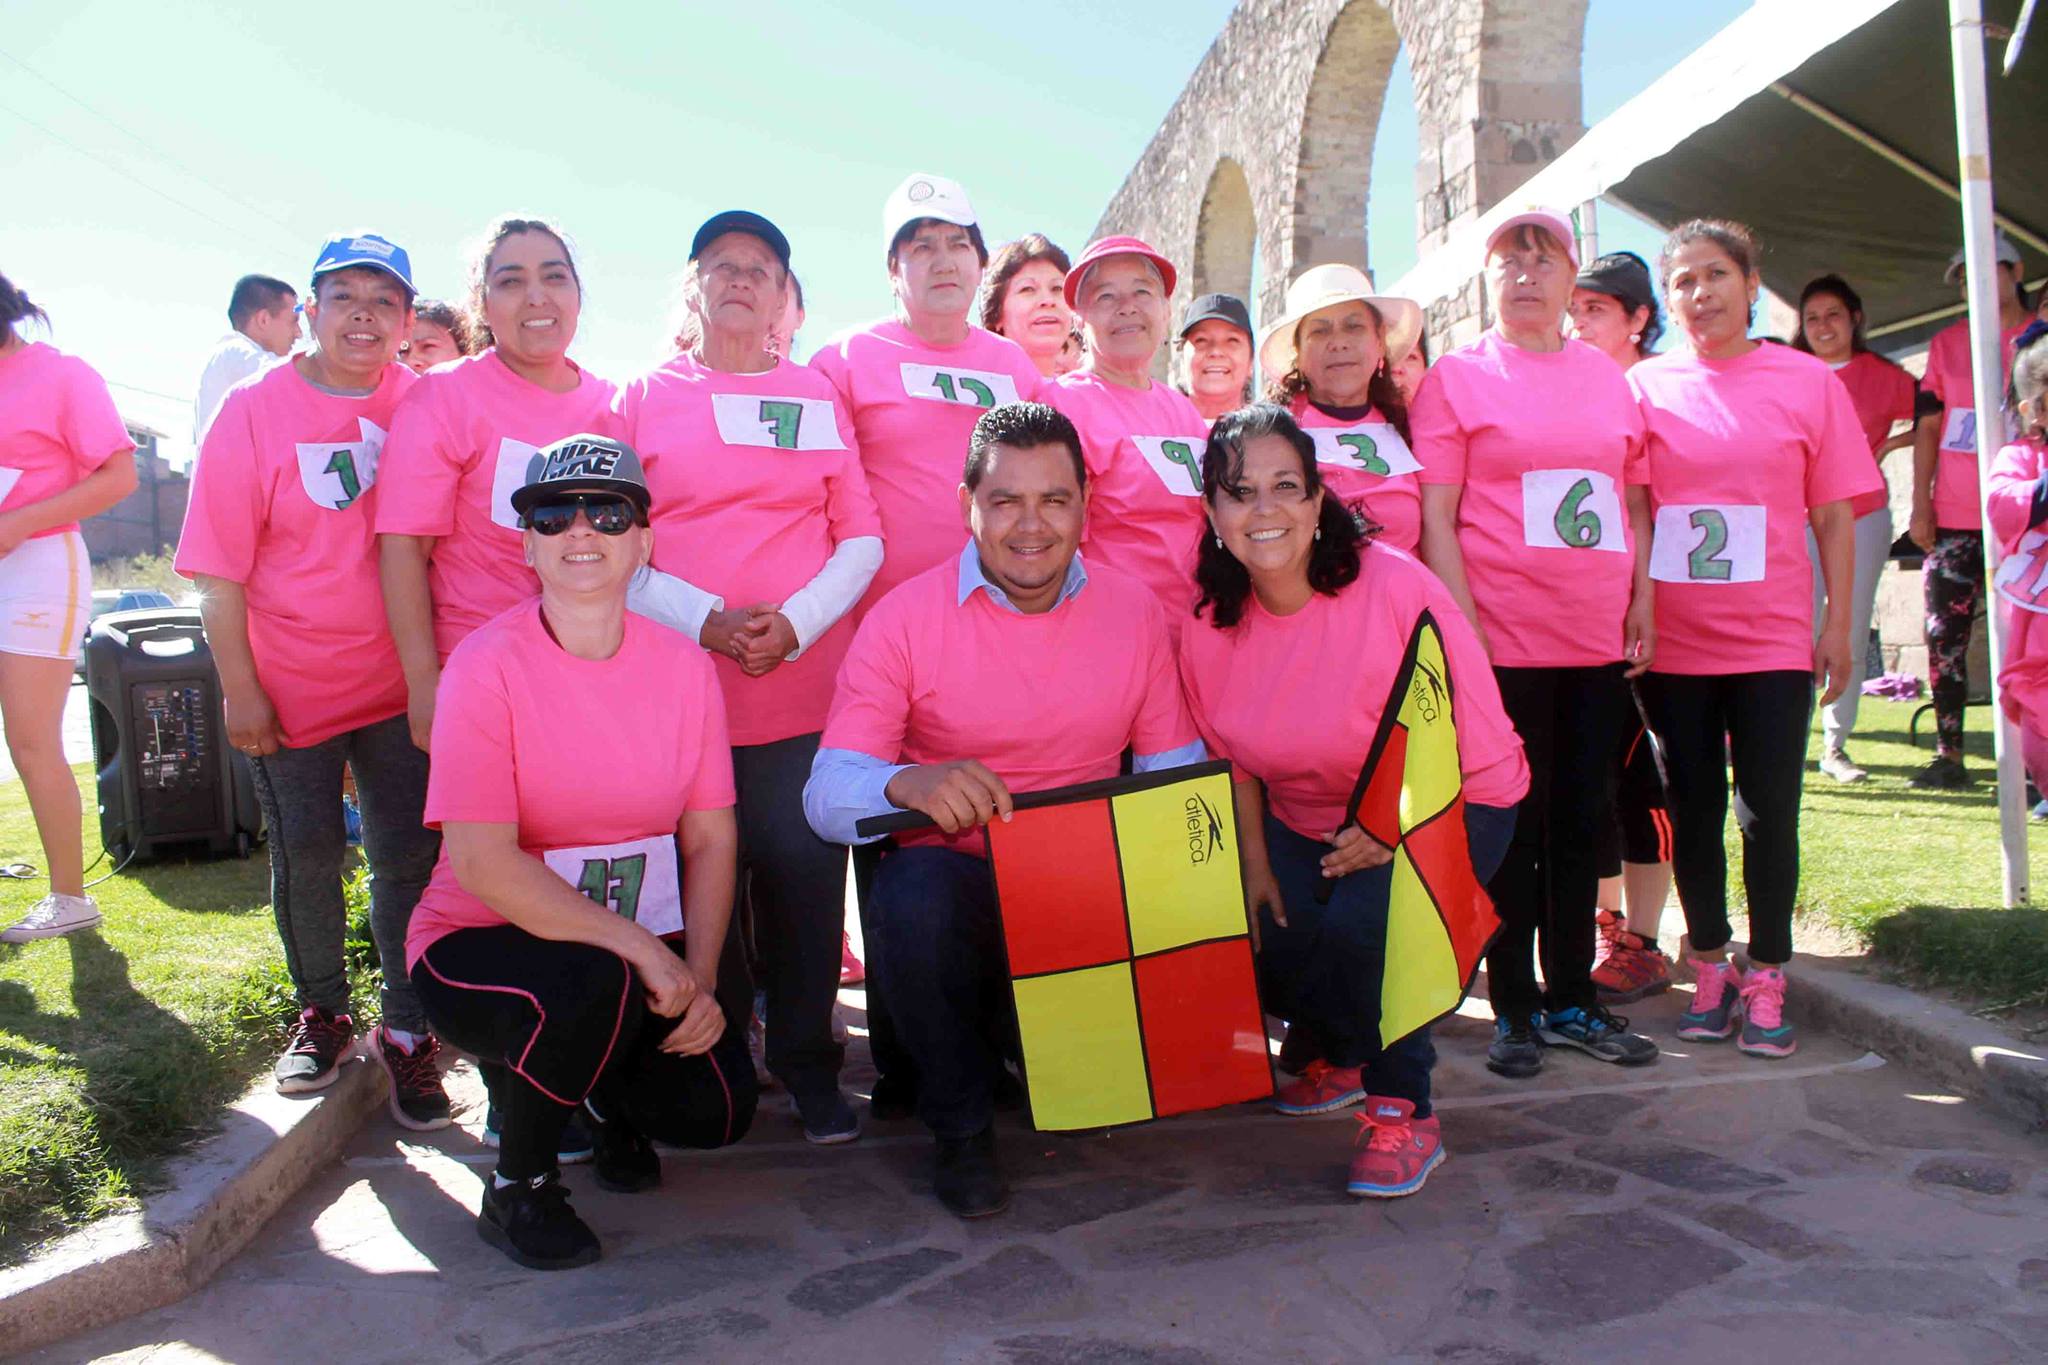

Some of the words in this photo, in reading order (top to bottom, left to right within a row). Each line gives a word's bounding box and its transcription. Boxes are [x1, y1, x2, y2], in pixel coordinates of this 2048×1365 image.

[759, 400, 803, 448] 7
[538, 443, 622, 483] NIKE
[1161, 440, 1204, 492] 9
[1336, 433, 1390, 475] 3
[1554, 477, 1601, 547] 6
[1688, 508, 1732, 580] 2
[1185, 797, 1205, 863] atletica
